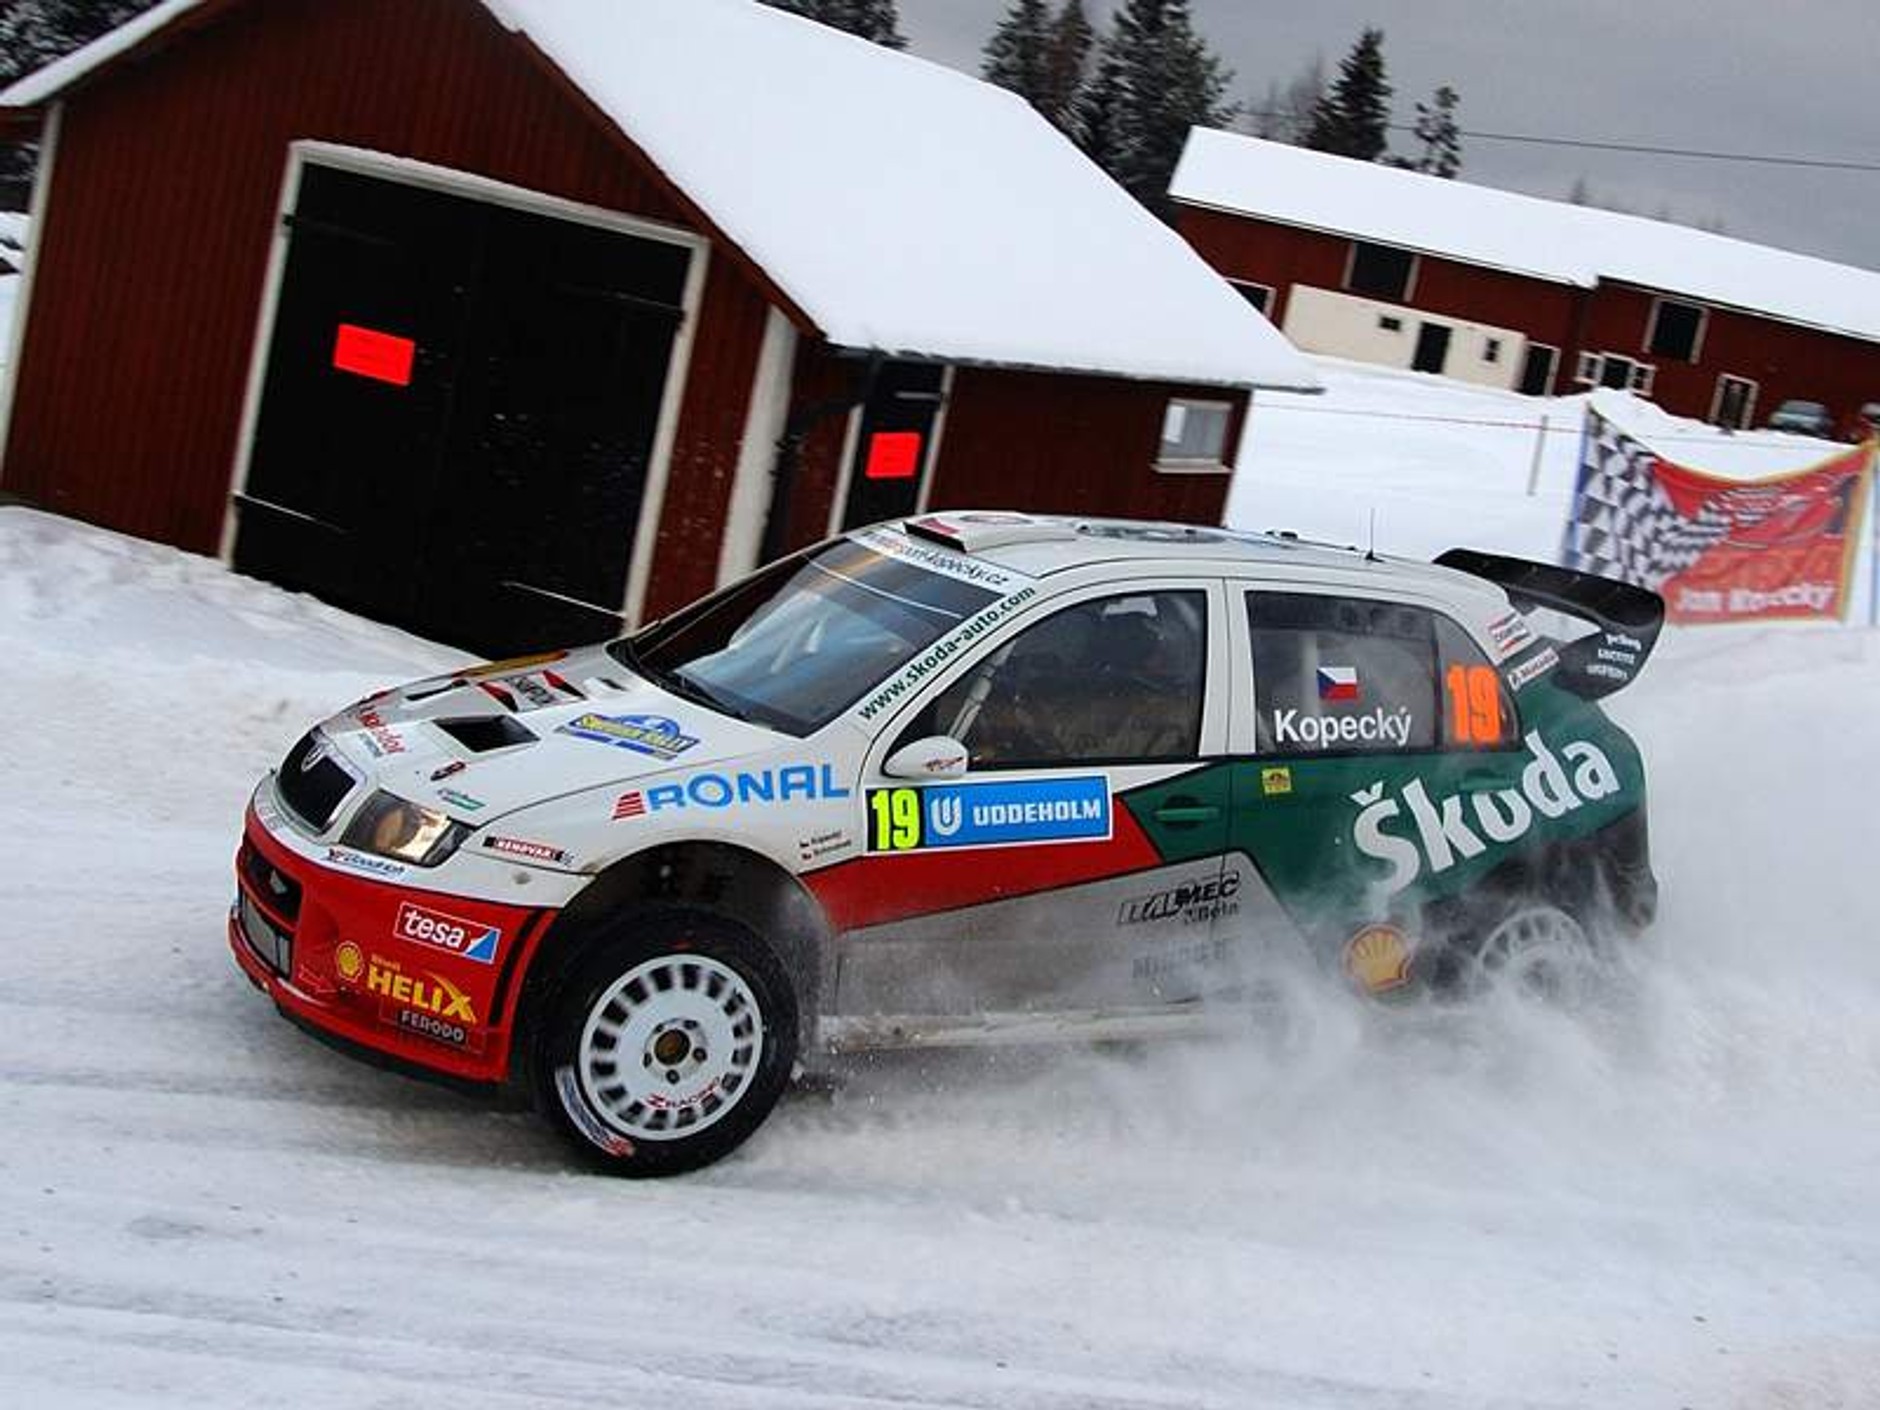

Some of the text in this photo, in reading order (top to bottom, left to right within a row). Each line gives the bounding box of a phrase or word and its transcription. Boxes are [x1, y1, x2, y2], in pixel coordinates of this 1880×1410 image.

[858, 586, 1036, 720] www.skoda-auto.com
[1274, 707, 1412, 748] Kopecký
[1447, 663, 1501, 744] 19
[646, 763, 850, 811] RONAL
[972, 798, 1101, 827] UDDEHOLM
[1351, 729, 1620, 893] Škoda
[872, 789, 920, 850] 19
[404, 909, 465, 948] tesa
[367, 964, 477, 1025] HELIX
[401, 1010, 465, 1043] FERODO
